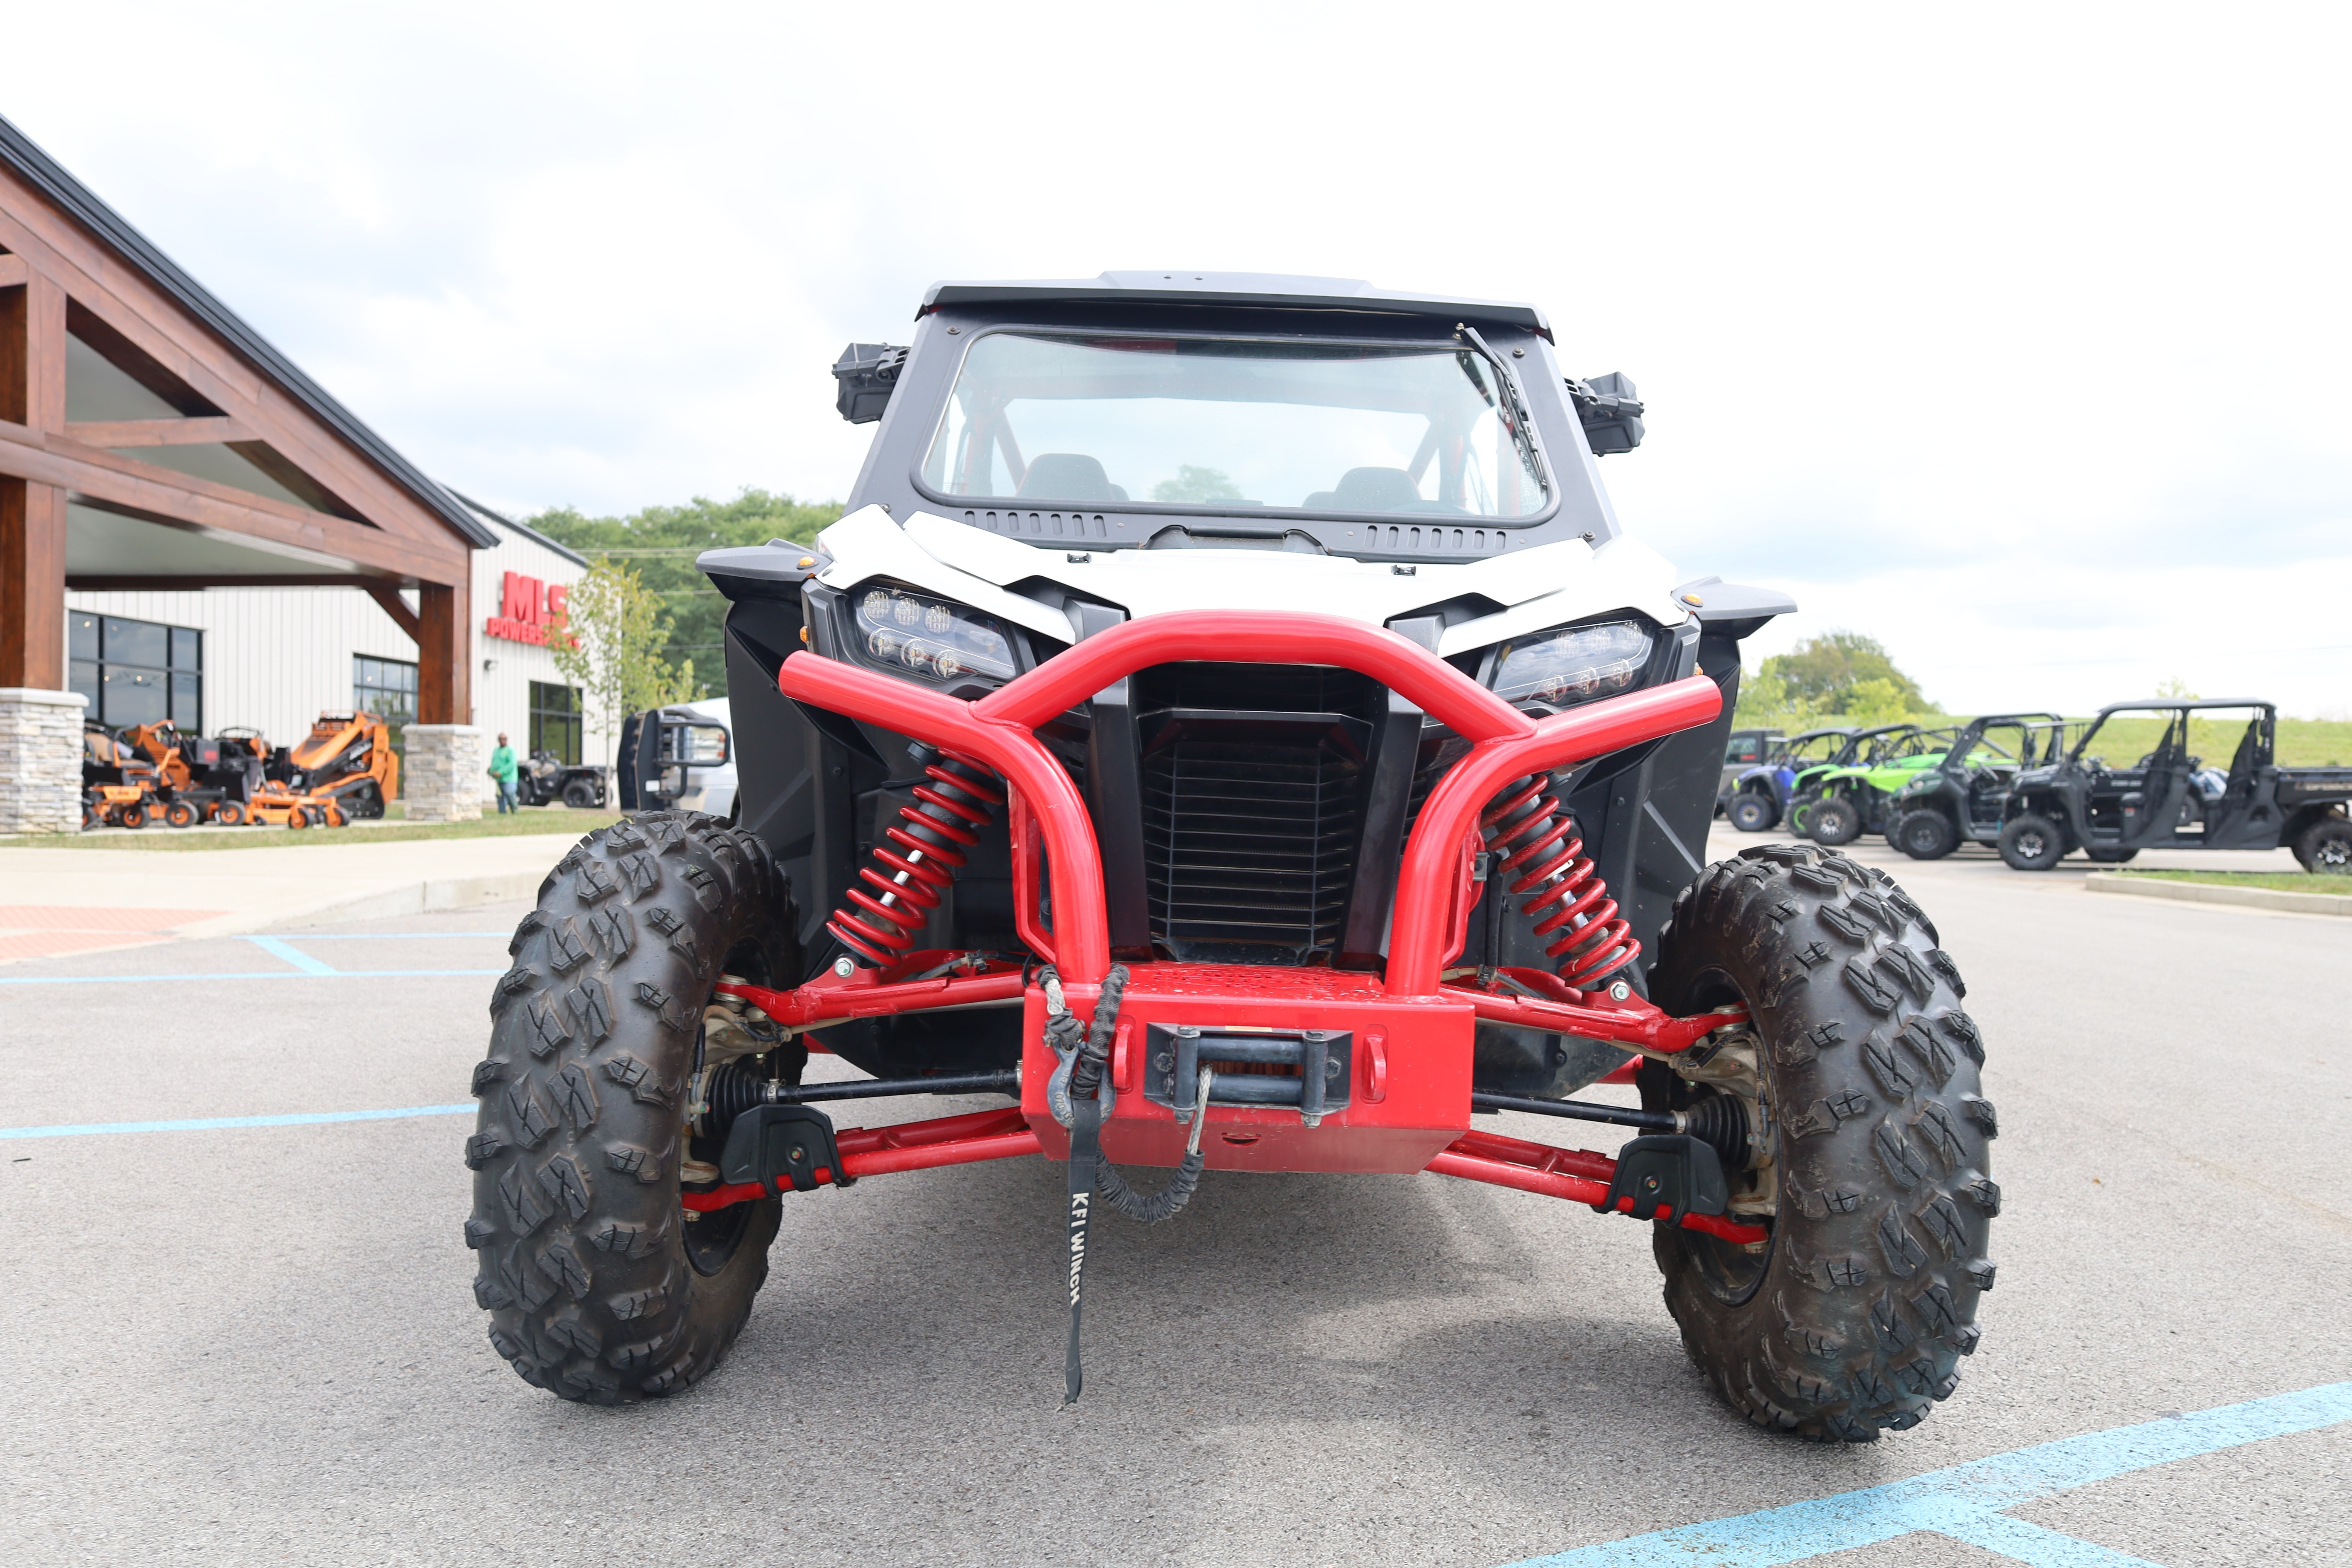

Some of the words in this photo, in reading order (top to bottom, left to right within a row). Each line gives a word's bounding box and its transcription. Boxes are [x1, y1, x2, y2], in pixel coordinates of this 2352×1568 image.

[502, 571, 568, 629] MLS
[1071, 1192, 1089, 1228] KFI
[1069, 1231, 1085, 1306] WINCH
